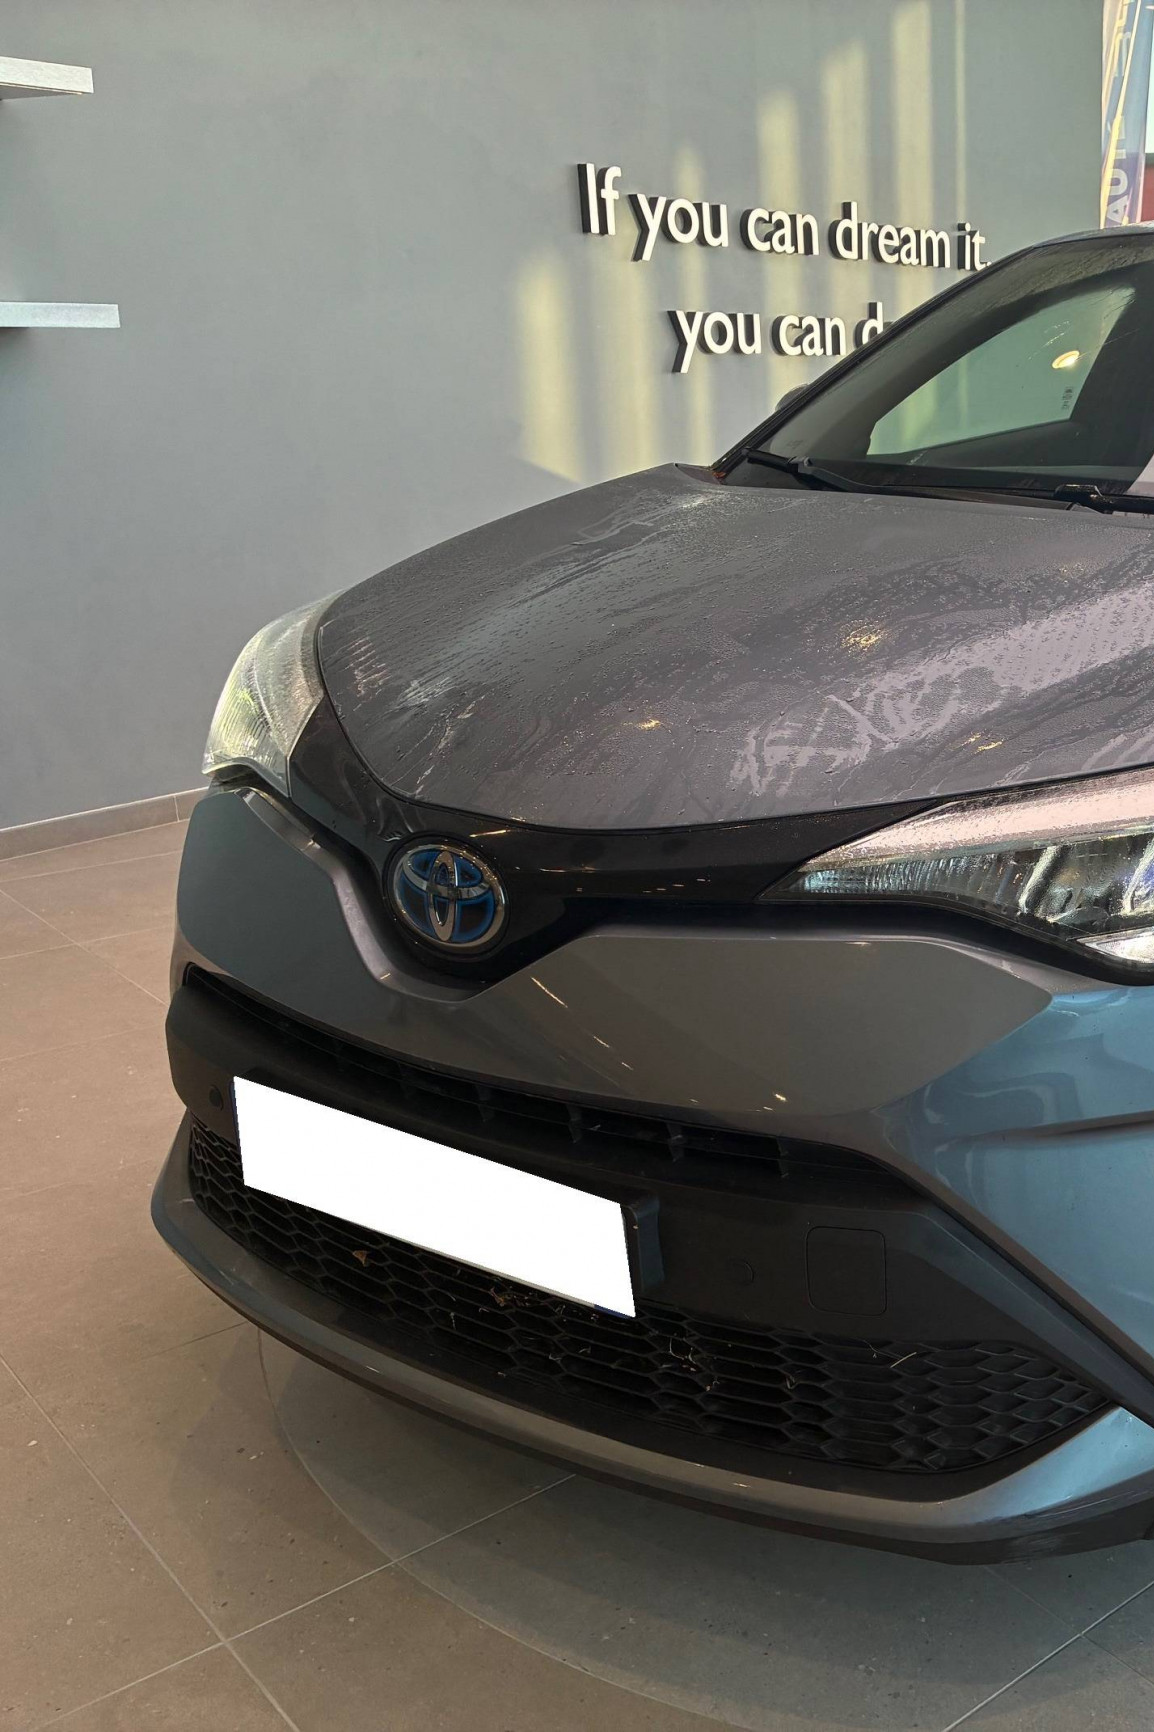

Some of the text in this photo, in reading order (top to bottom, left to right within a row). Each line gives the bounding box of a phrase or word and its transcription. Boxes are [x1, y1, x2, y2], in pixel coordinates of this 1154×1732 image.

[578, 163, 622, 236] If
[629, 193, 729, 262] you
[740, 207, 819, 256] can
[829, 201, 951, 269] dream
[668, 309, 762, 373] you
[771, 313, 846, 356] can
